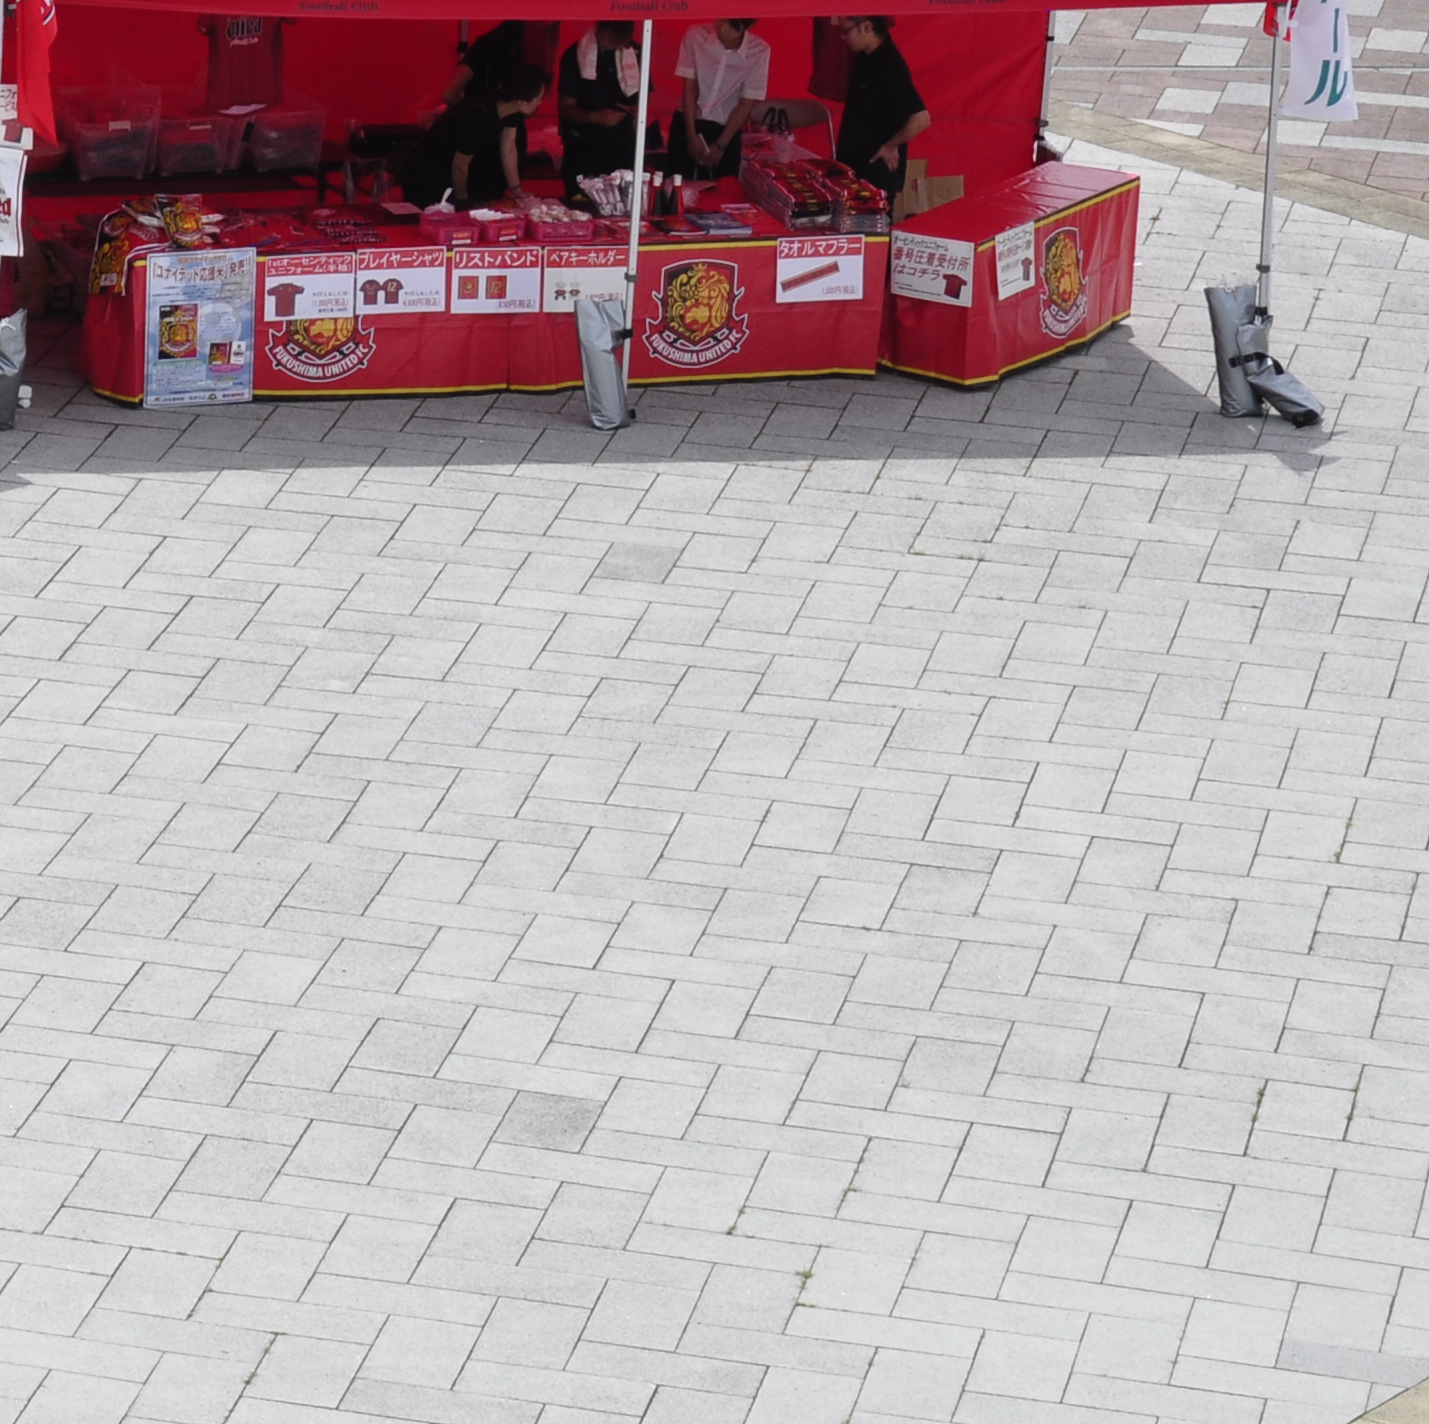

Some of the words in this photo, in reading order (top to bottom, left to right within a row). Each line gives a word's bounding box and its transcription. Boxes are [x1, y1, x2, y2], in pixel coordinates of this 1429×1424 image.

[779, 238, 862, 258] タオルマフラー
[359, 250, 443, 269] プレイヤーシャツ
[455, 250, 538, 268] リストバンド
[893, 246, 971, 272] 番号圧着受付所
[892, 263, 941, 281] はコチラ
[649, 333, 698, 364] FUKUSHIMA
[698, 341, 732, 363] UNITED
[727, 329, 742, 343] FC
[273, 345, 323, 377] FUKUSHIMA
[324, 355, 360, 377] UNITED
[355, 344, 370, 359] FC
